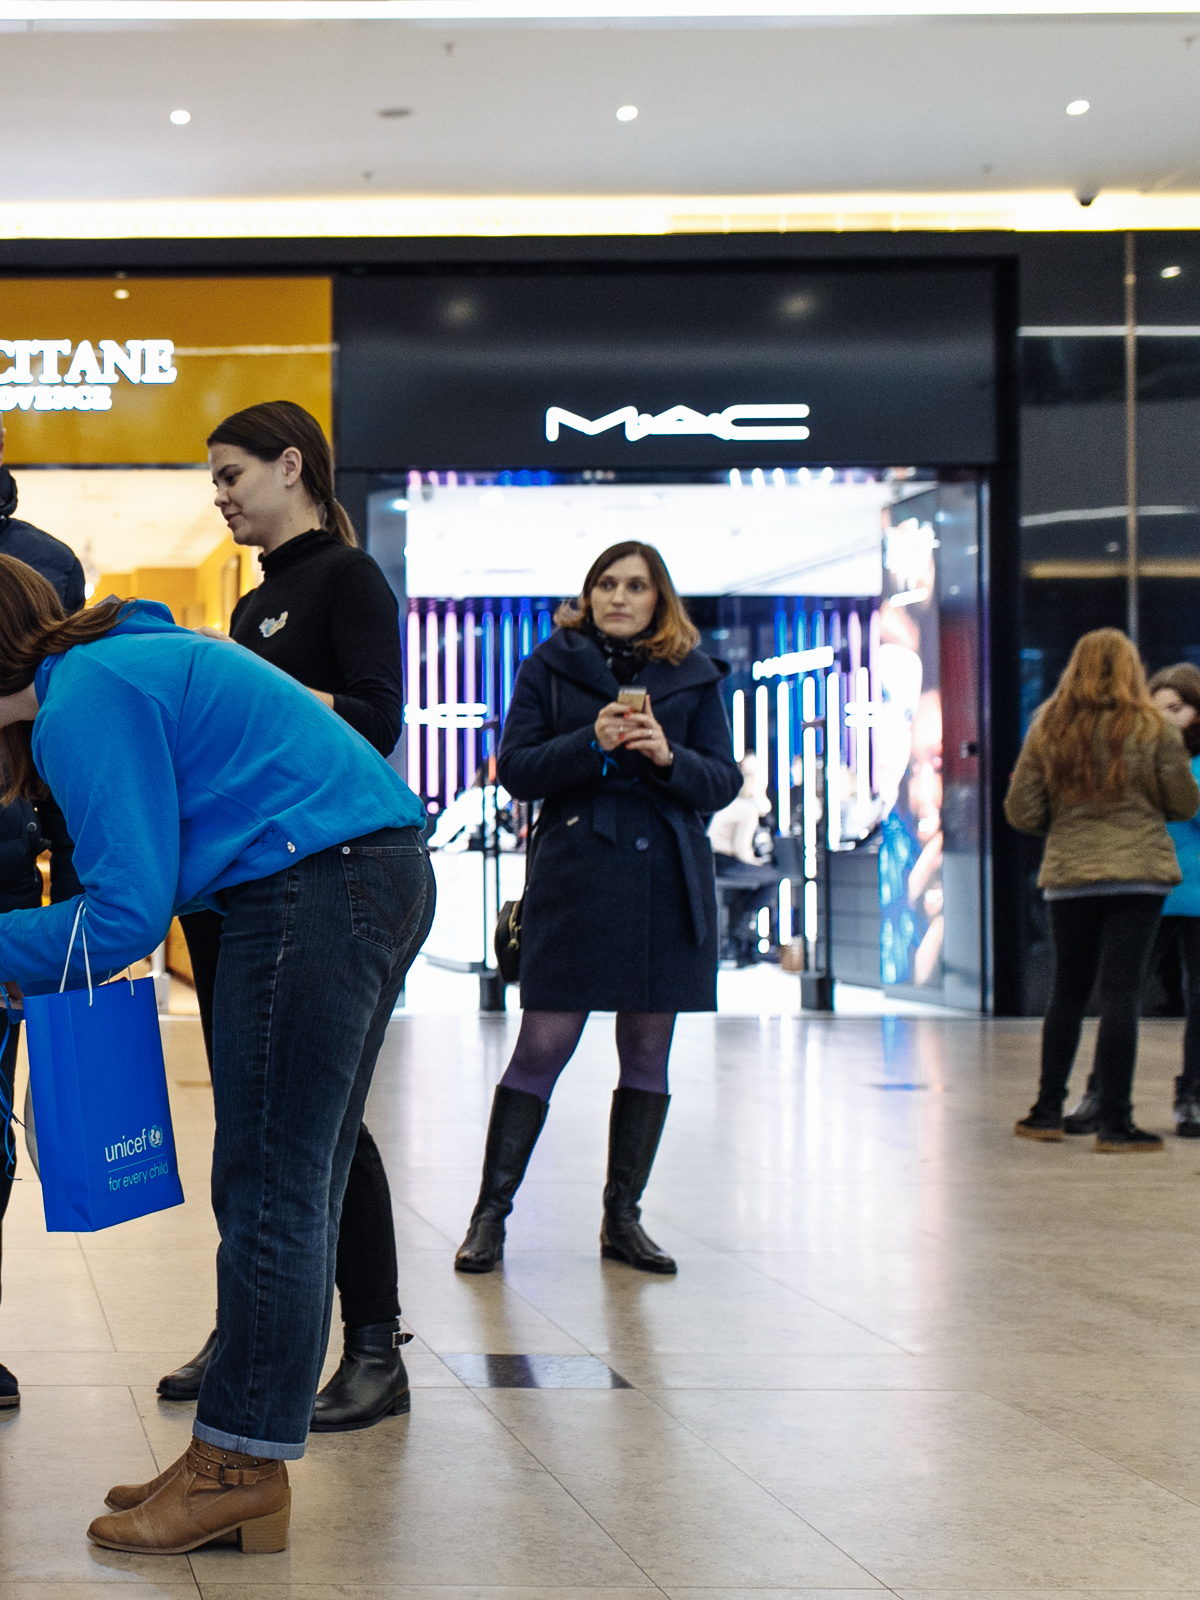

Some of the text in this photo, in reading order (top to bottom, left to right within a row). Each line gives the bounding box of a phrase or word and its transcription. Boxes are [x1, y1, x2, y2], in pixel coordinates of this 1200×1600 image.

[105, 1128, 147, 1162] unicef
[108, 1160, 169, 1191] for every child
